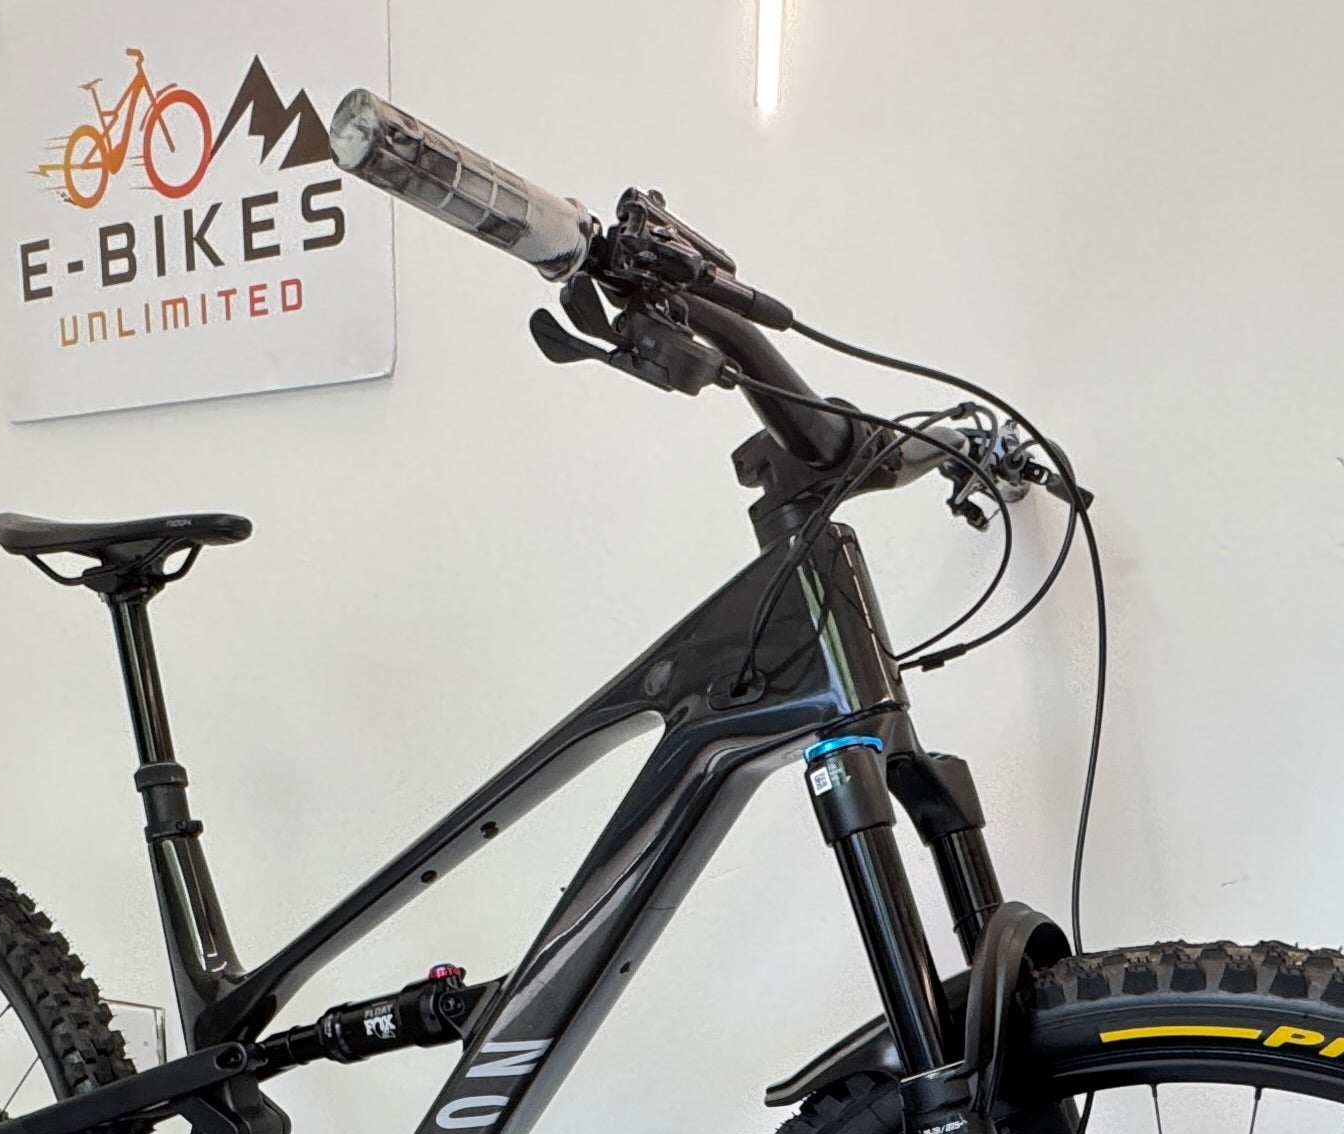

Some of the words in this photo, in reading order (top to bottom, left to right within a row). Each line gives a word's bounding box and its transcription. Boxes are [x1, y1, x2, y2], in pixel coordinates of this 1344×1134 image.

[20, 179, 346, 303] E-BIKES
[60, 278, 303, 347] UNLIMITED
[363, 1014, 396, 1039] FOX
